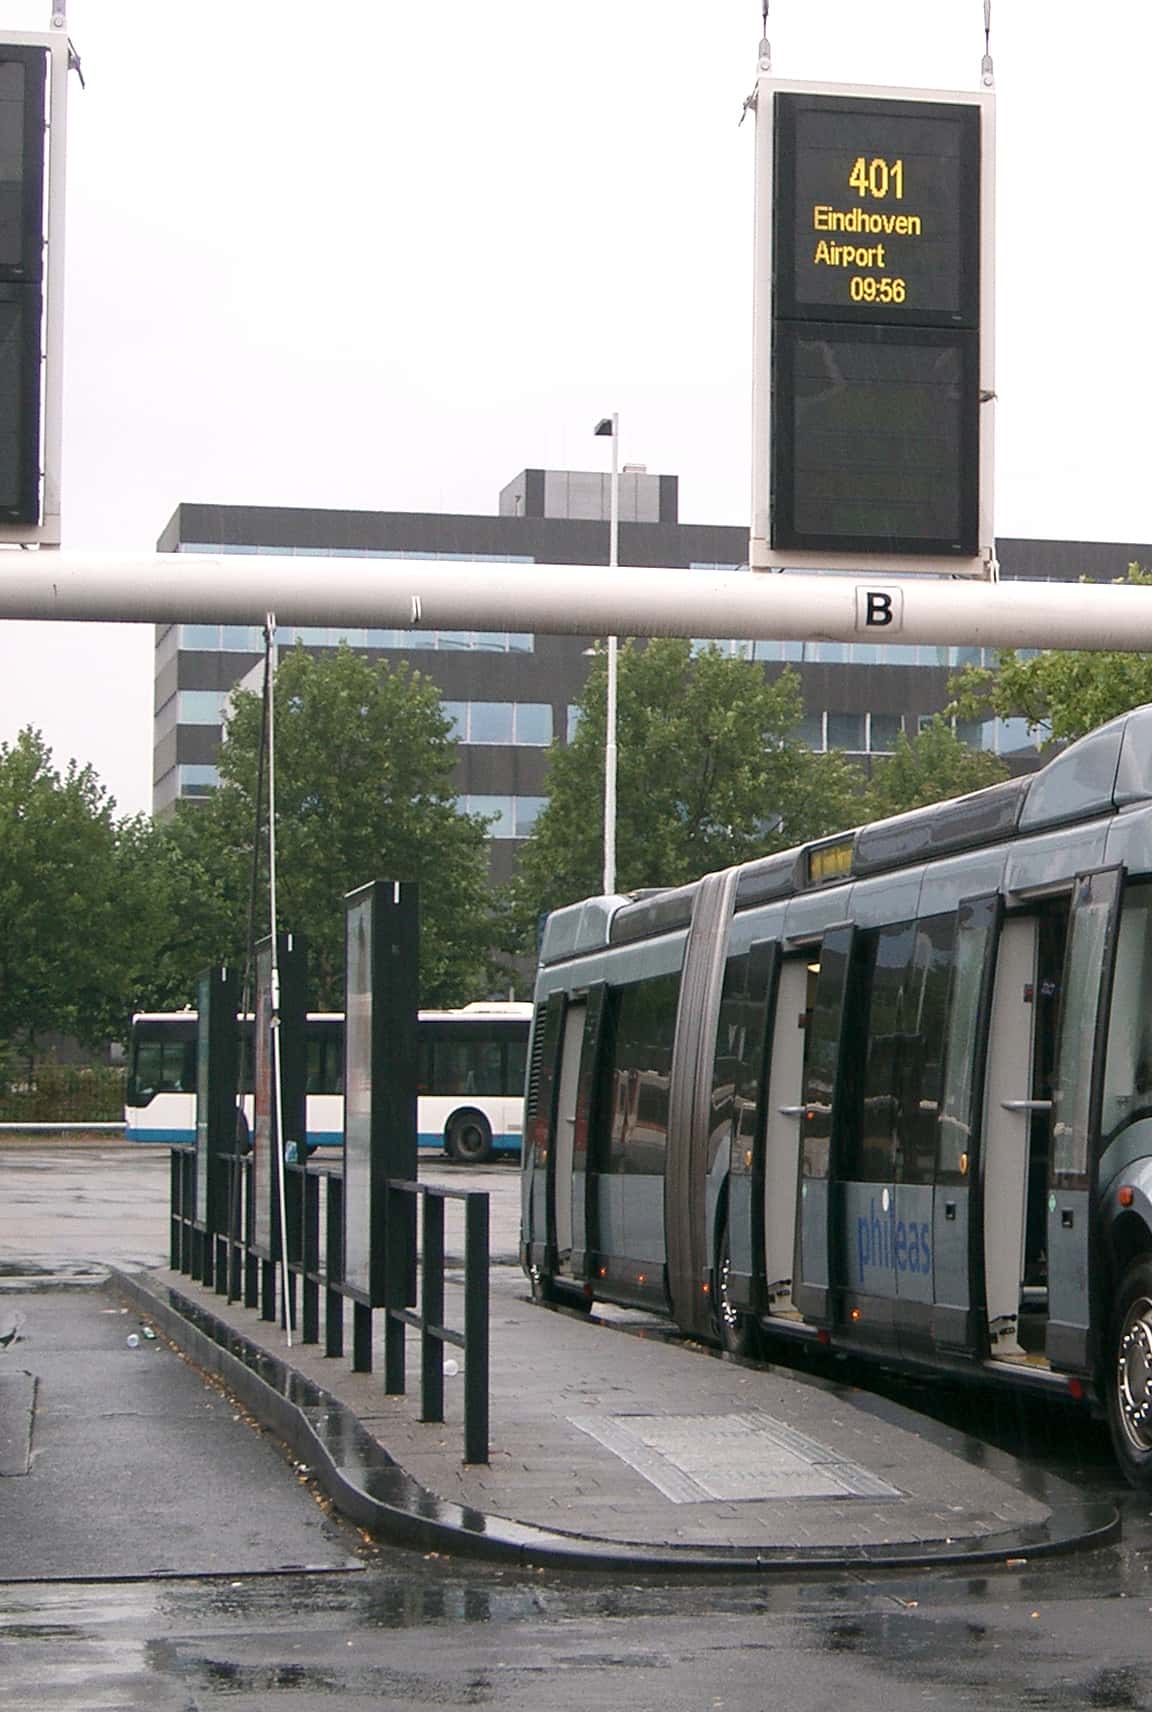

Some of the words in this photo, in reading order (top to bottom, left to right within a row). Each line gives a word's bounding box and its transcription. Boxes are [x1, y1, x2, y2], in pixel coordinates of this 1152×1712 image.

[849, 156, 904, 200] 401
[813, 205, 922, 236] Eindhoven
[814, 240, 886, 268] Airport
[850, 277, 906, 304] 09:56
[866, 592, 893, 626] B
[857, 1196, 931, 1284] phileas
